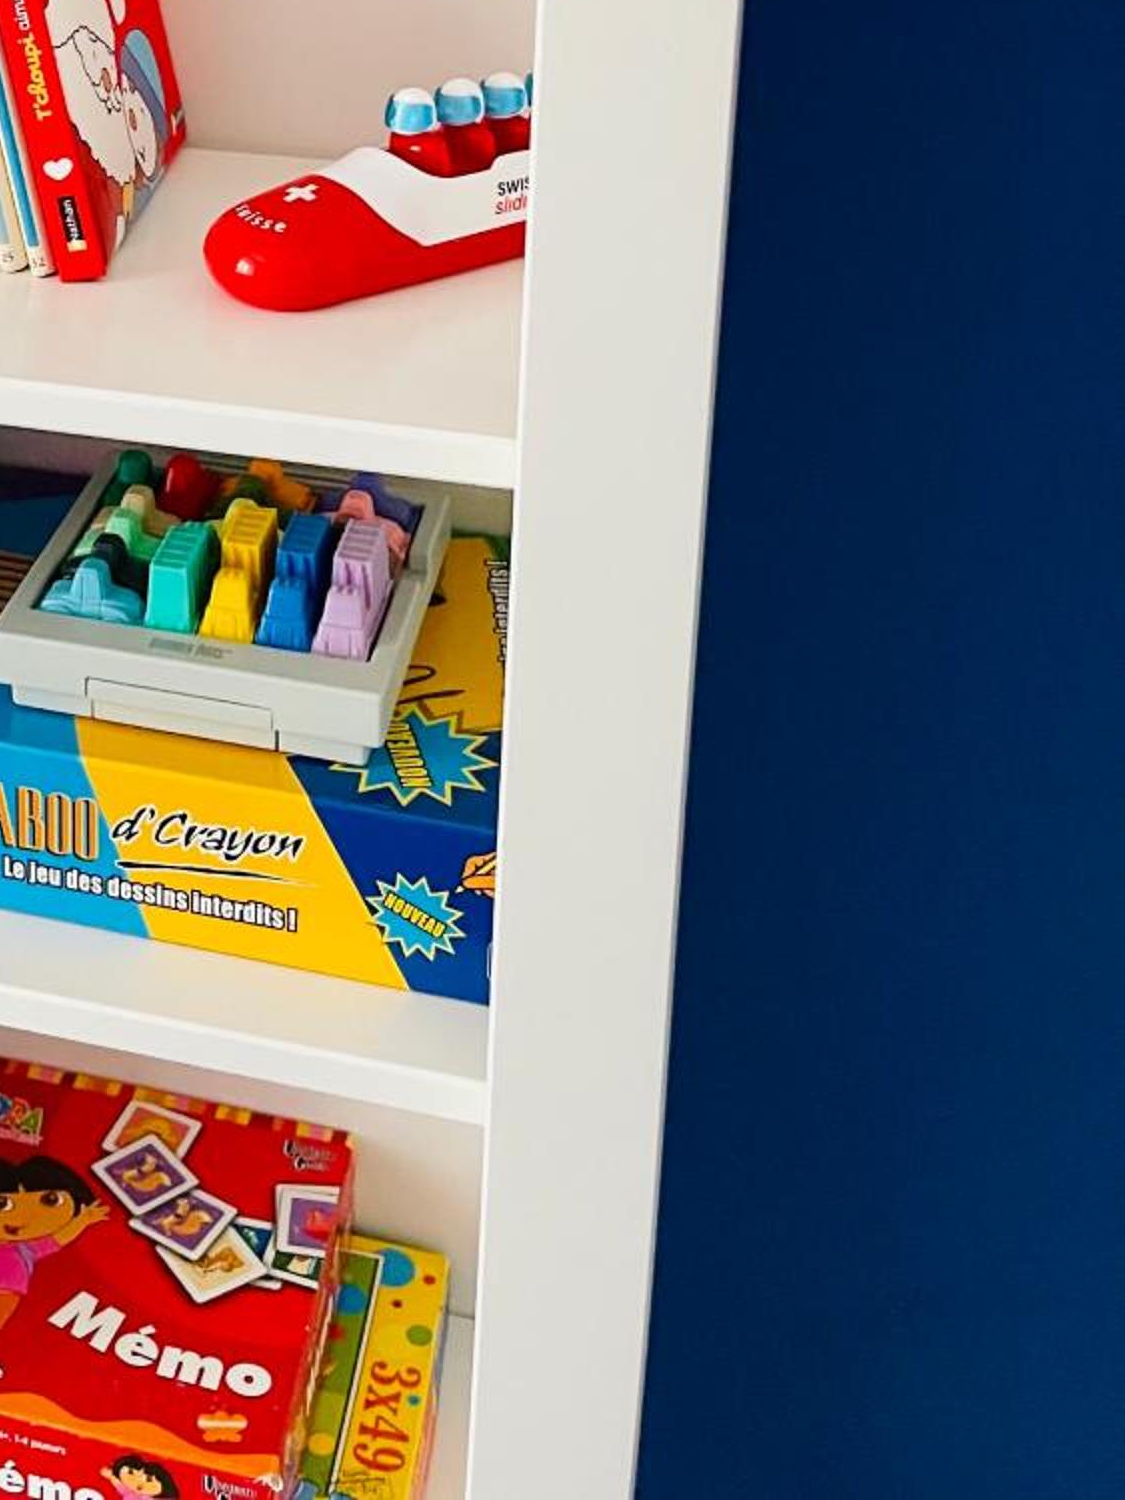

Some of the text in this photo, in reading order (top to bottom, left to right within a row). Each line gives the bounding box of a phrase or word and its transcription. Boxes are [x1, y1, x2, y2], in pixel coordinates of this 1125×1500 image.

[17, 33, 52, 123] T'choupi
[2, 855, 299, 933] Le jeu des dessins interdits !
[383, 890, 448, 941] NOUVEAU
[47, 1290, 273, 1398] Mémo
[353, 1359, 423, 1474] 3x49
